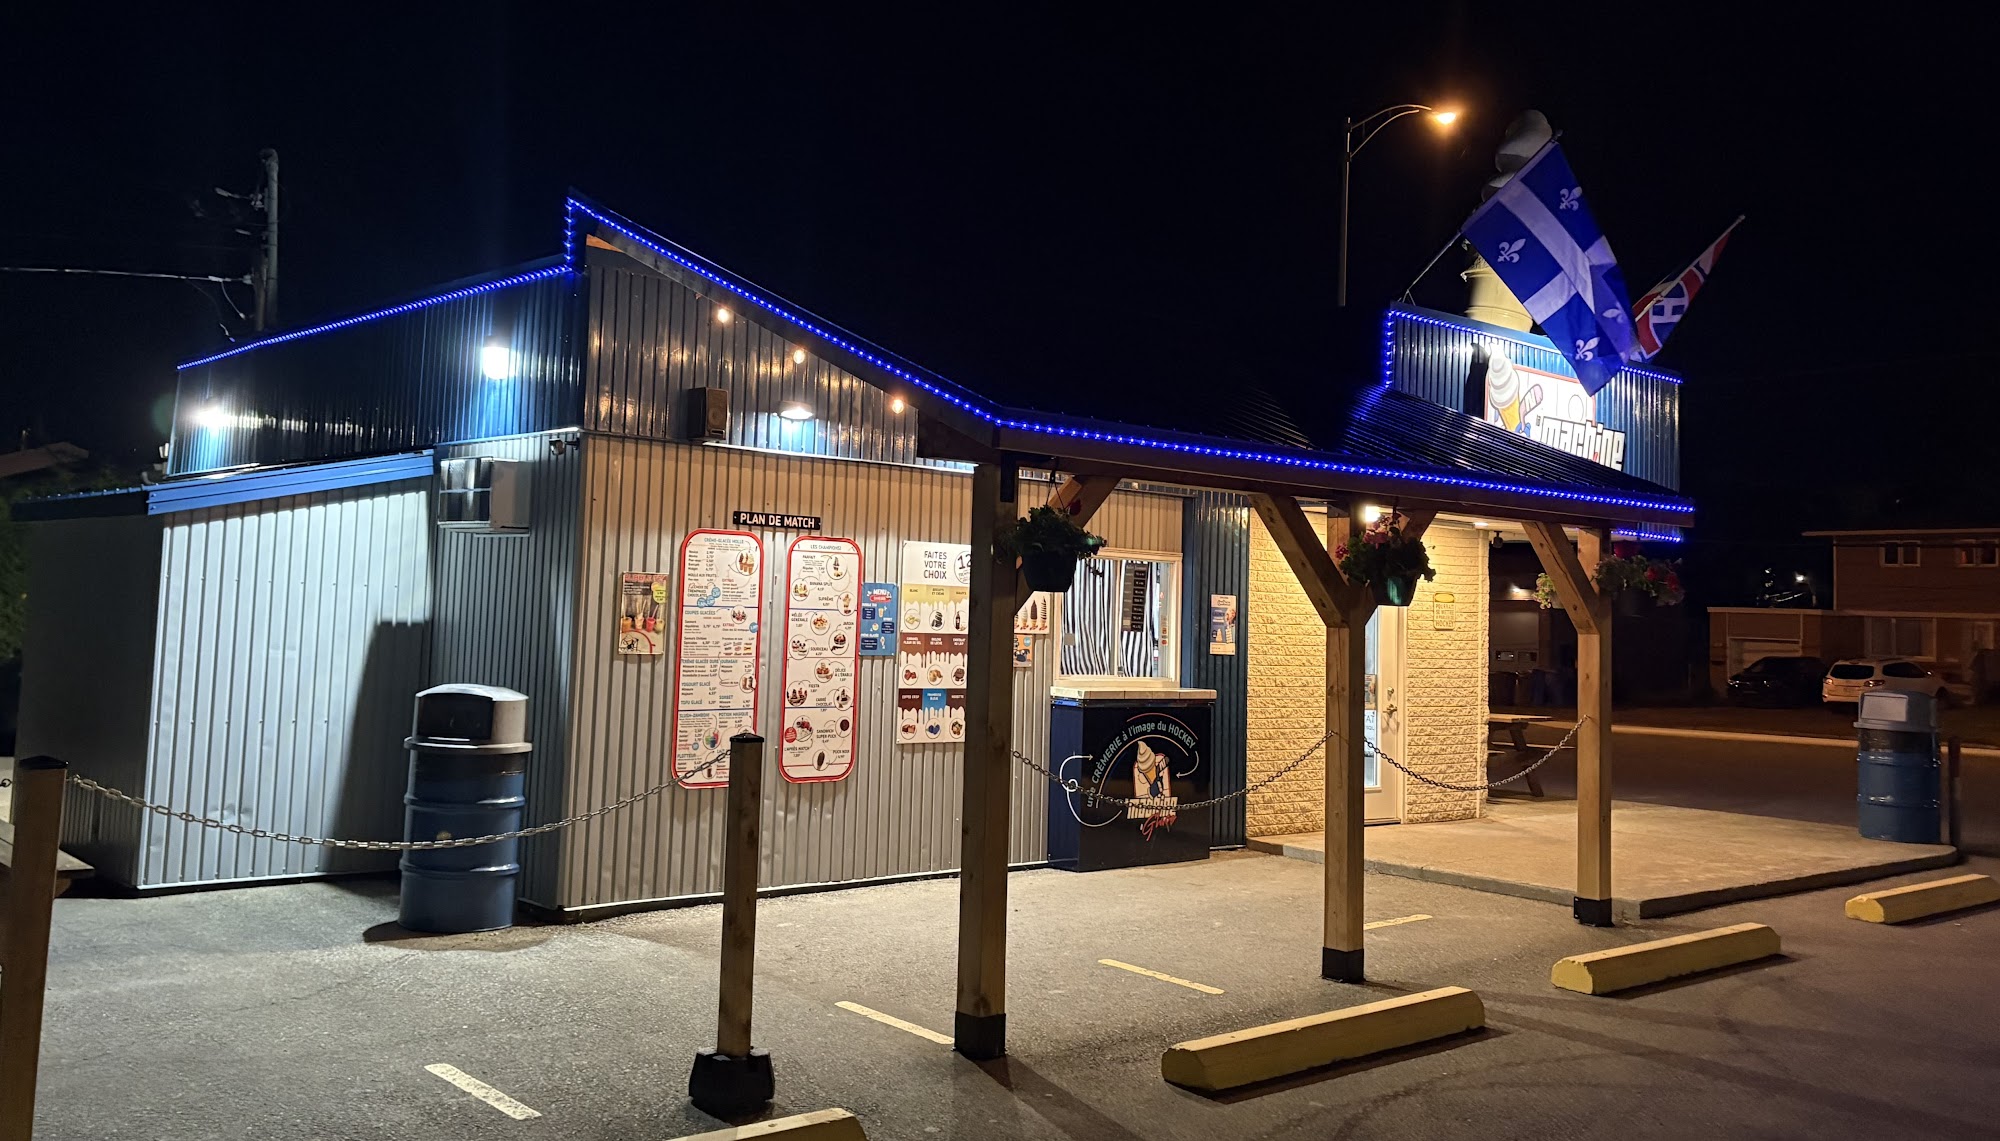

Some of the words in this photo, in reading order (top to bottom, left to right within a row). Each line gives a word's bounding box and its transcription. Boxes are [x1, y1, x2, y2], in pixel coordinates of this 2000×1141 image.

[1541, 416, 1625, 472] machine
[740, 513, 766, 525] PLAN
[768, 515, 782, 526] DE
[783, 516, 815, 528] MATCH
[924, 551, 947, 560] FAITES
[957, 553, 972, 570] 12
[924, 560, 947, 569] VOTRE
[923, 570, 947, 580] CHOIX
[1091, 736, 1123, 784] CRÈMERIE
[1122, 730, 1129, 741] à
[1128, 721, 1156, 737] l'image
[1157, 720, 1167, 731] du
[1168, 723, 1196, 749] HOCKEY
